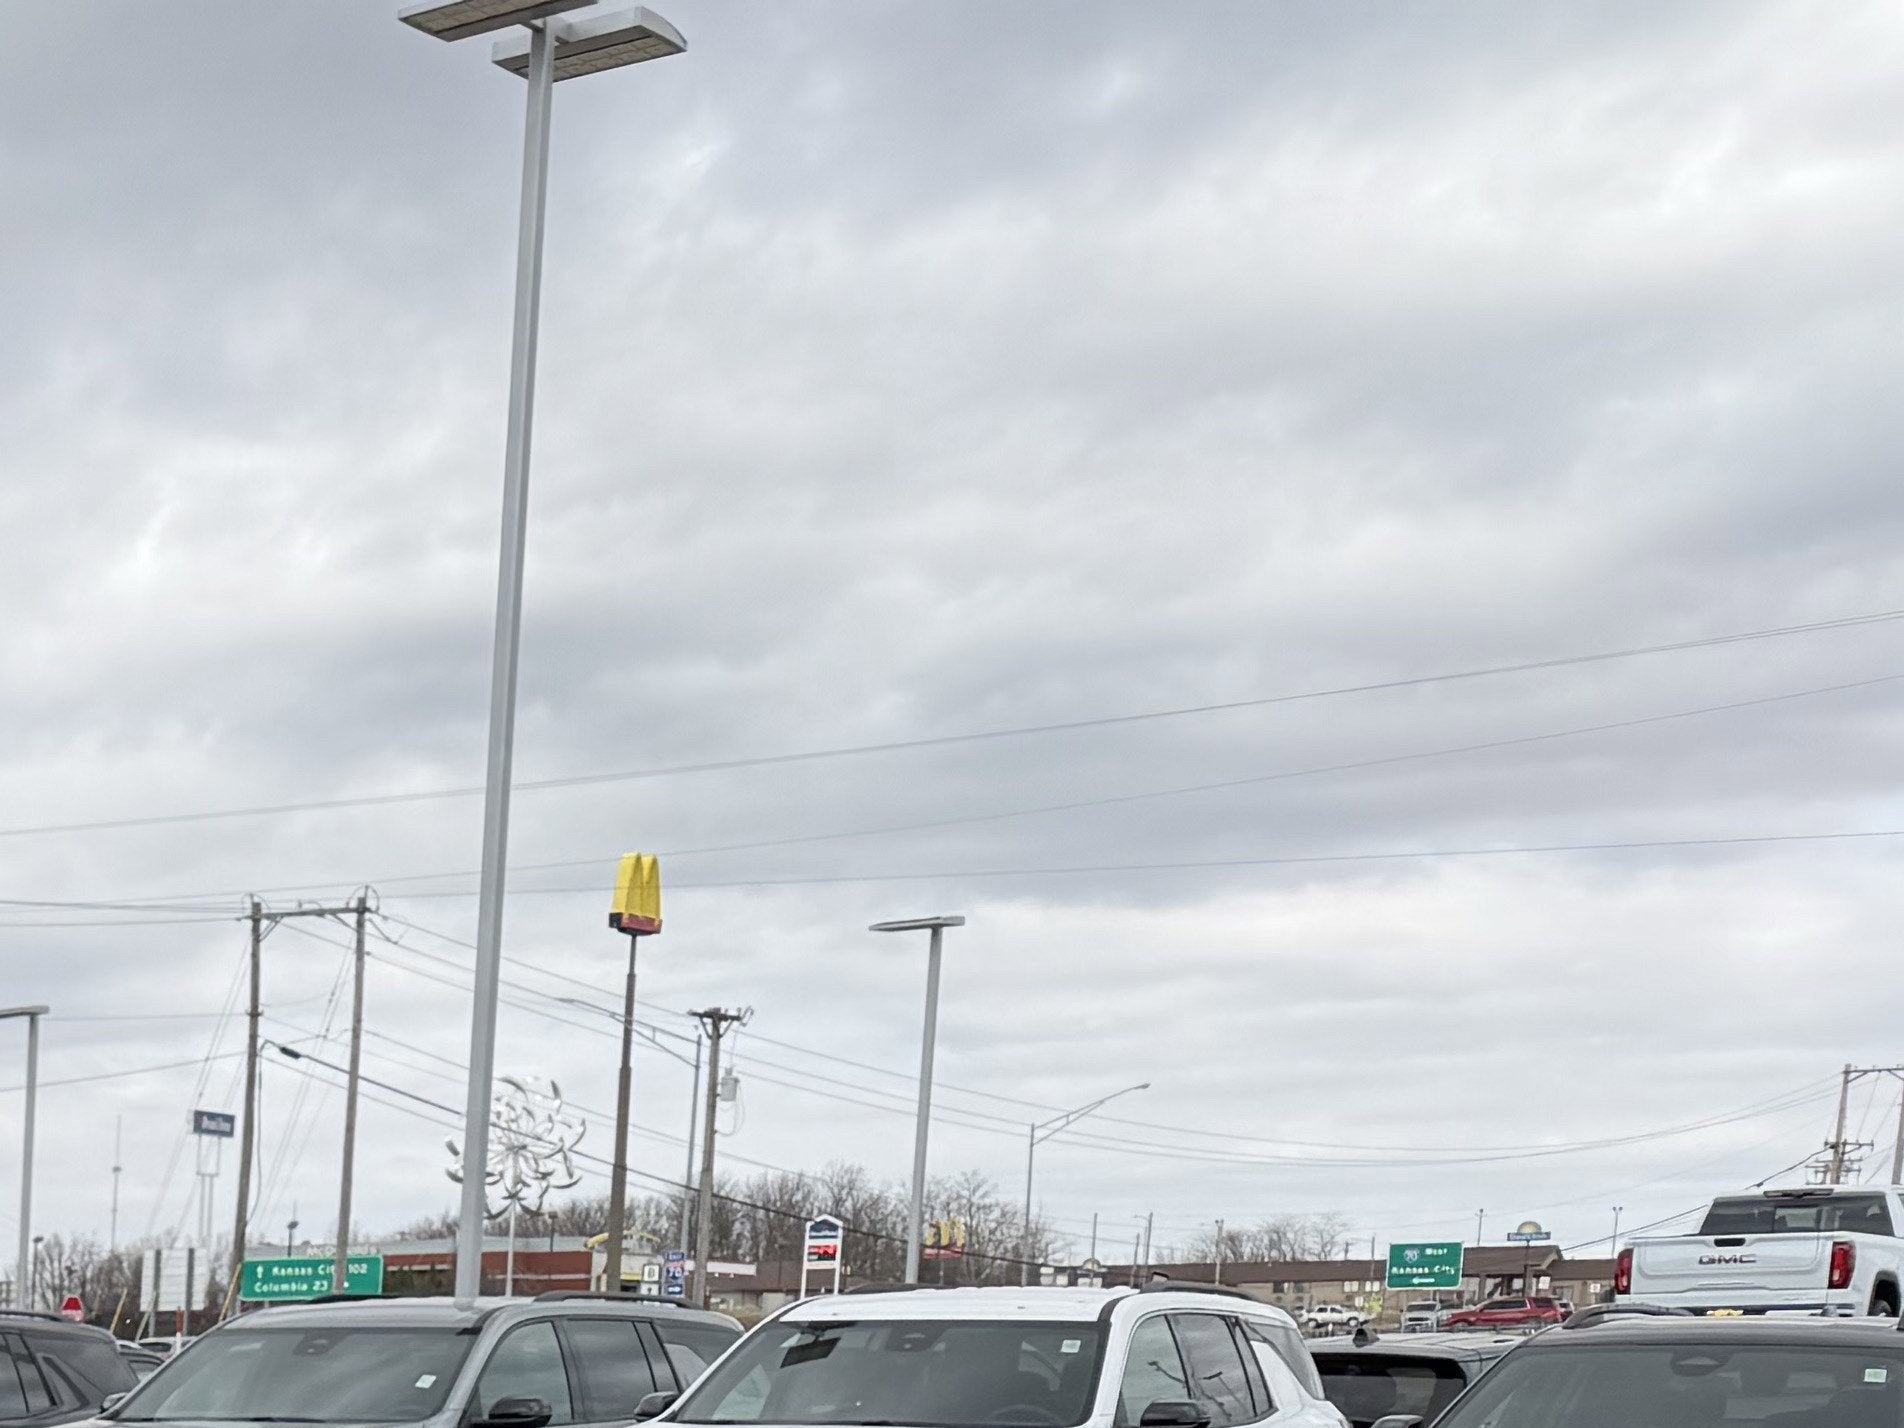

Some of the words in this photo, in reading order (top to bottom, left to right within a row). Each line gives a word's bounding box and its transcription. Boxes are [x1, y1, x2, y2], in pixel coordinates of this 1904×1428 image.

[1698, 1254, 1757, 1265] GMC
[272, 1266, 313, 1277] Kansas
[348, 1263, 368, 1275] 102
[1433, 1264, 1455, 1275] City
[254, 1281, 309, 1293] Columbia
[312, 1280, 329, 1291] 23
